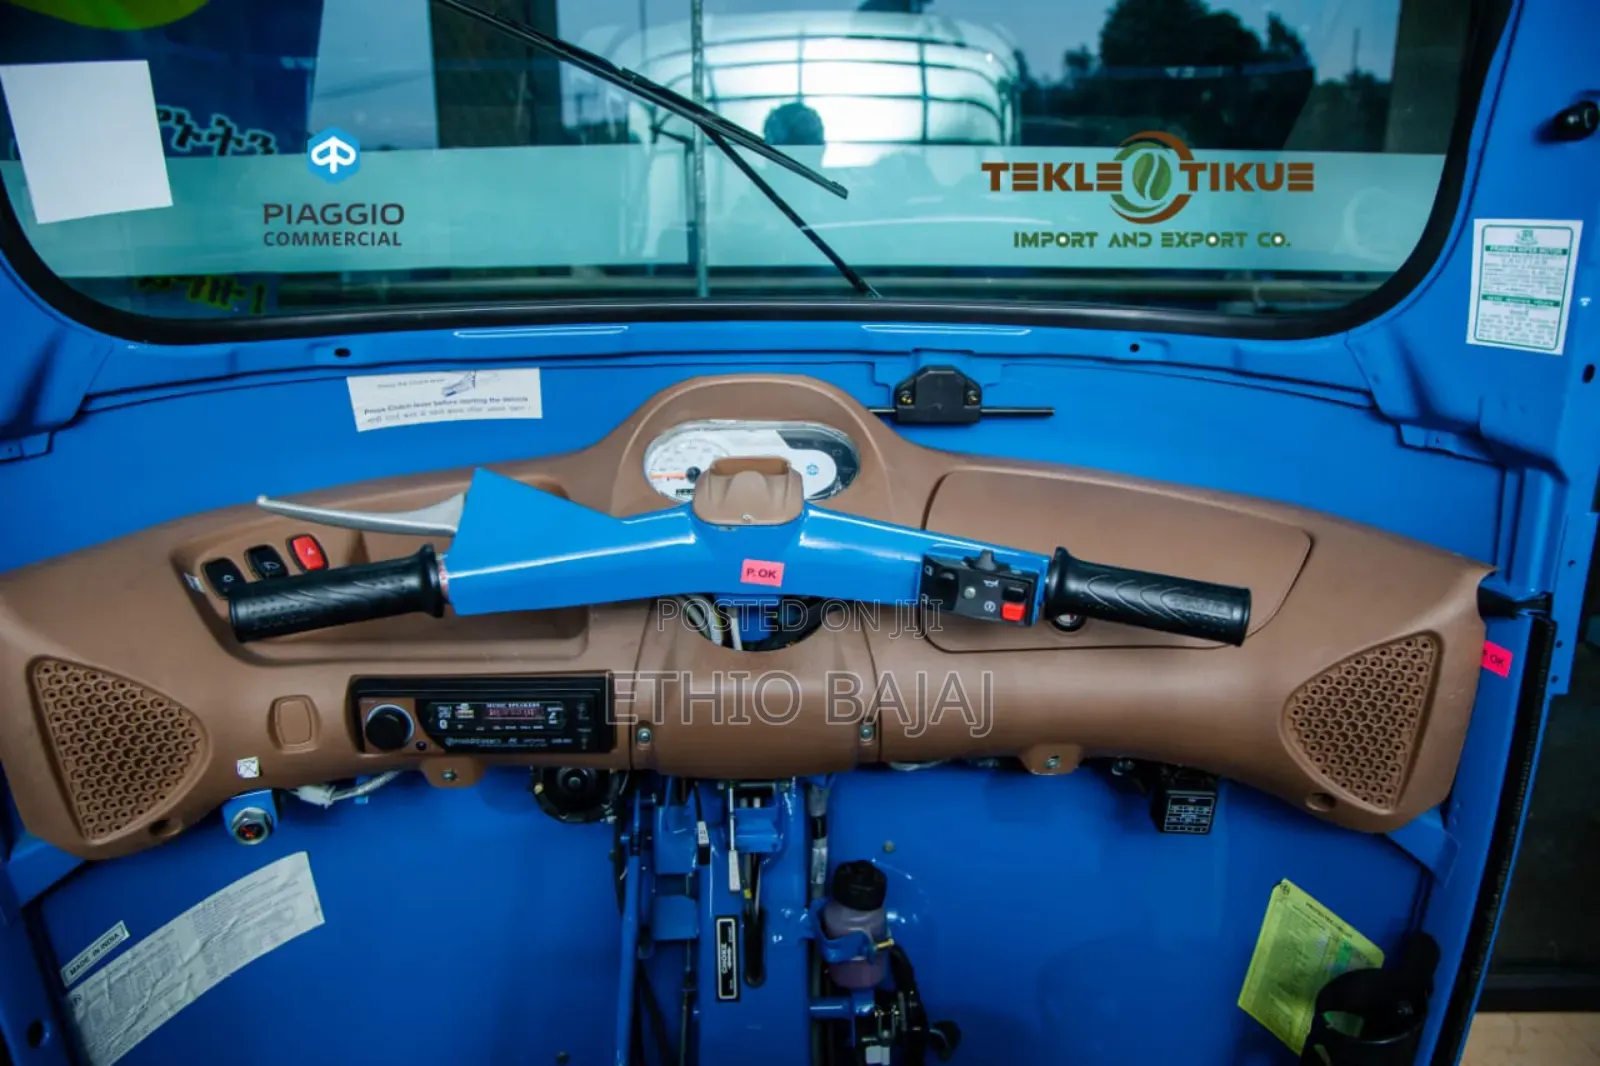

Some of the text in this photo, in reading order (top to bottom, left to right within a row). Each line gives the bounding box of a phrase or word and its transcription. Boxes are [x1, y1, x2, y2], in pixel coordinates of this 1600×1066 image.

[981, 162, 1315, 192] TEKLE TIKUE
[263, 202, 405, 226] PIAGGIO
[263, 231, 402, 247] COMMERCIAL
[1013, 231, 1291, 248] IMPORT AND EXPORT CO.
[69, 956, 89, 976] MADE
[100, 932, 120, 950] INDIA
